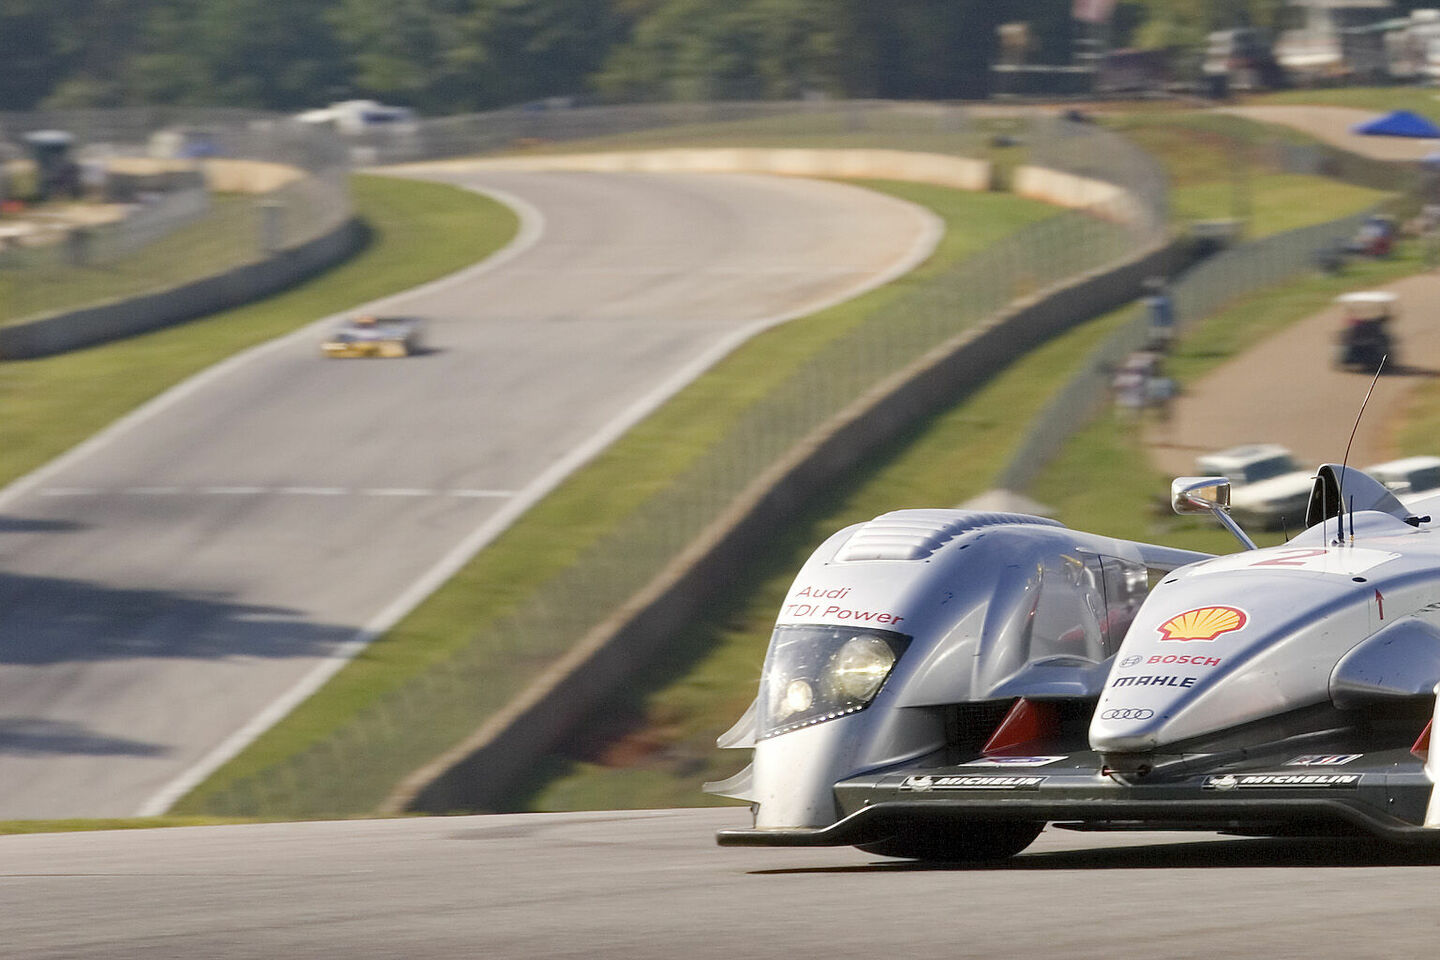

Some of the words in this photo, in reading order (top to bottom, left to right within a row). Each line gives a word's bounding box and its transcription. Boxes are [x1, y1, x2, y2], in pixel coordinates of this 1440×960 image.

[1248, 549, 1329, 566] 2
[795, 586, 852, 600] Audi
[822, 605, 904, 625] Power
[1146, 655, 1222, 667] BOSCH
[1111, 675, 1198, 688] MAHLE
[934, 777, 1044, 786] MICHELIN
[1240, 775, 1358, 784] MICHELIN
